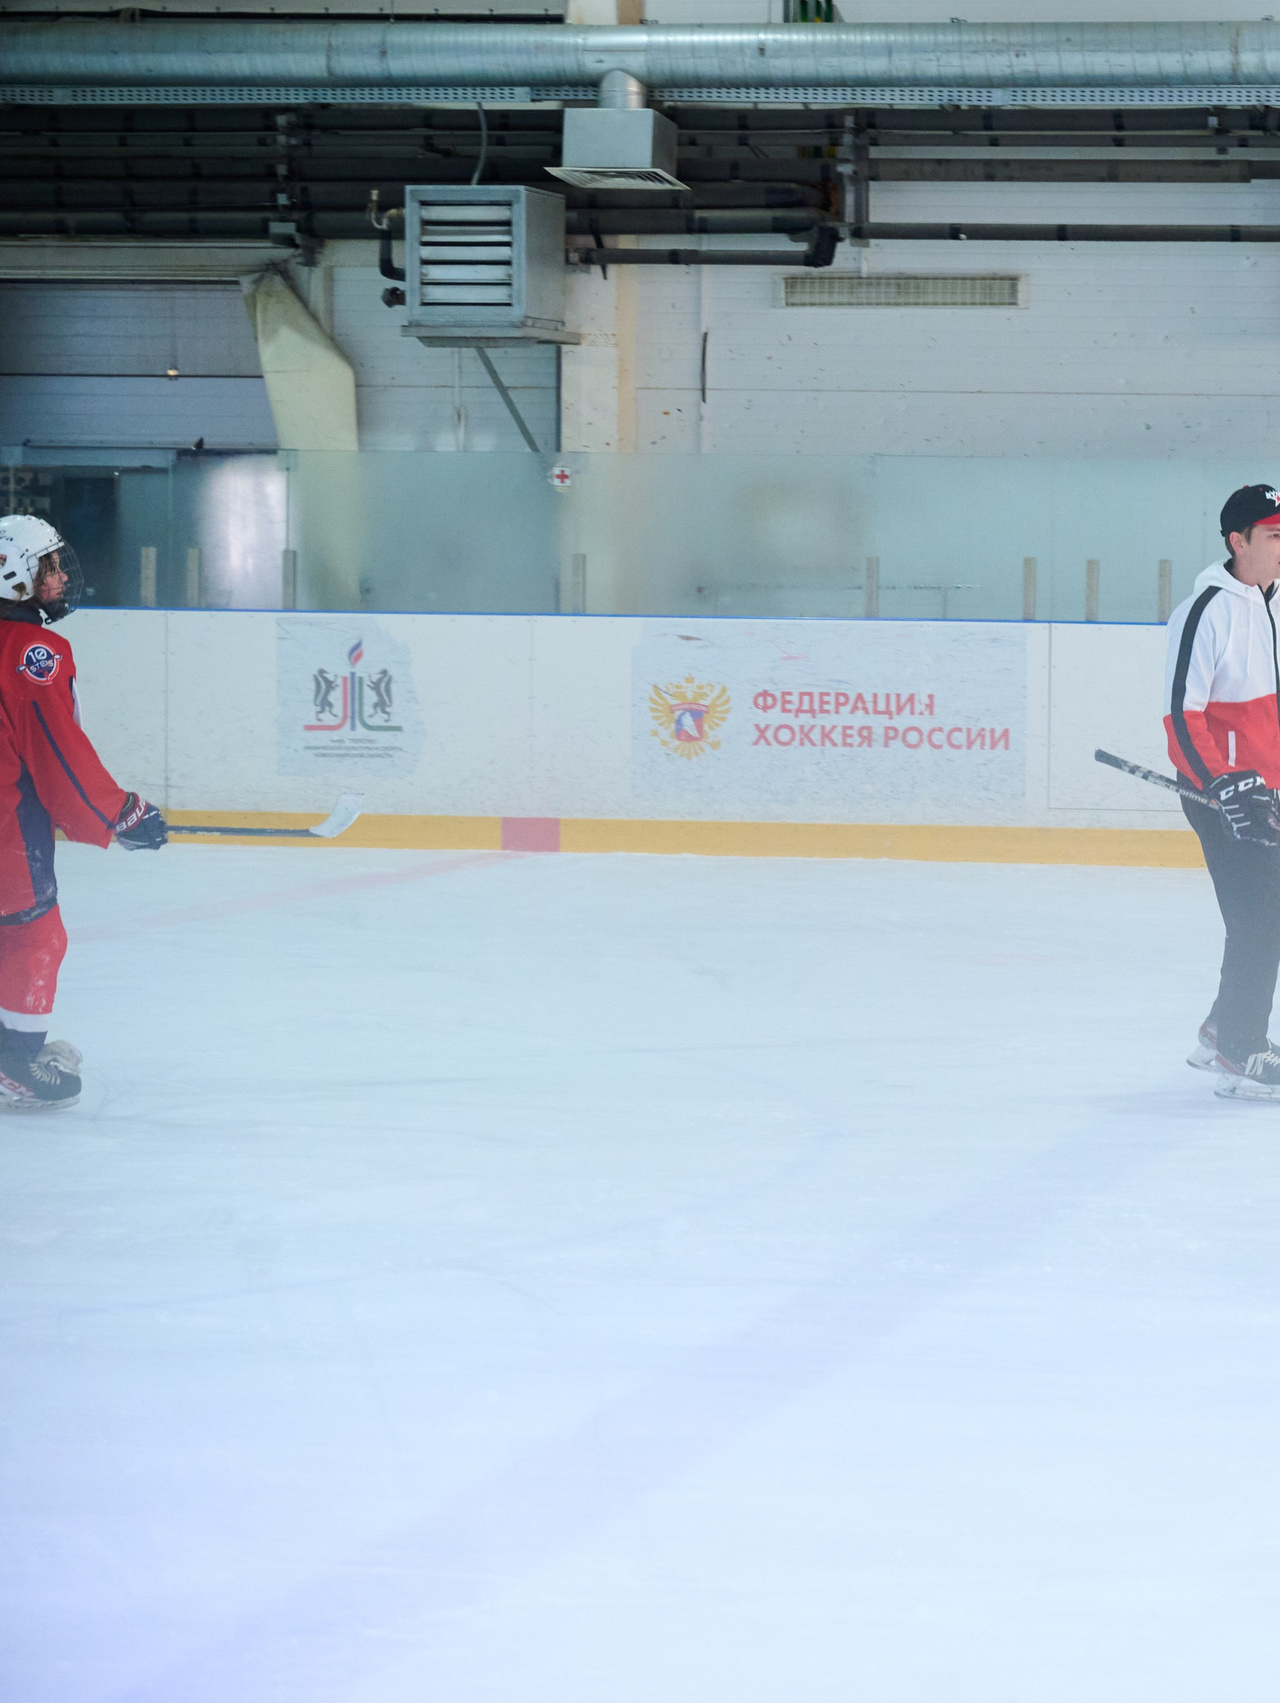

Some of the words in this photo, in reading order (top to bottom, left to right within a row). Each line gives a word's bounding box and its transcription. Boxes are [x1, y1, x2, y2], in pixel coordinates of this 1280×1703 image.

[28, 648, 47, 663] 10
[753, 690, 936, 719] ФЕДЕРАЦИЯ
[752, 724, 874, 749] ХОККЕЯ
[884, 726, 1011, 751] РОССИИ
